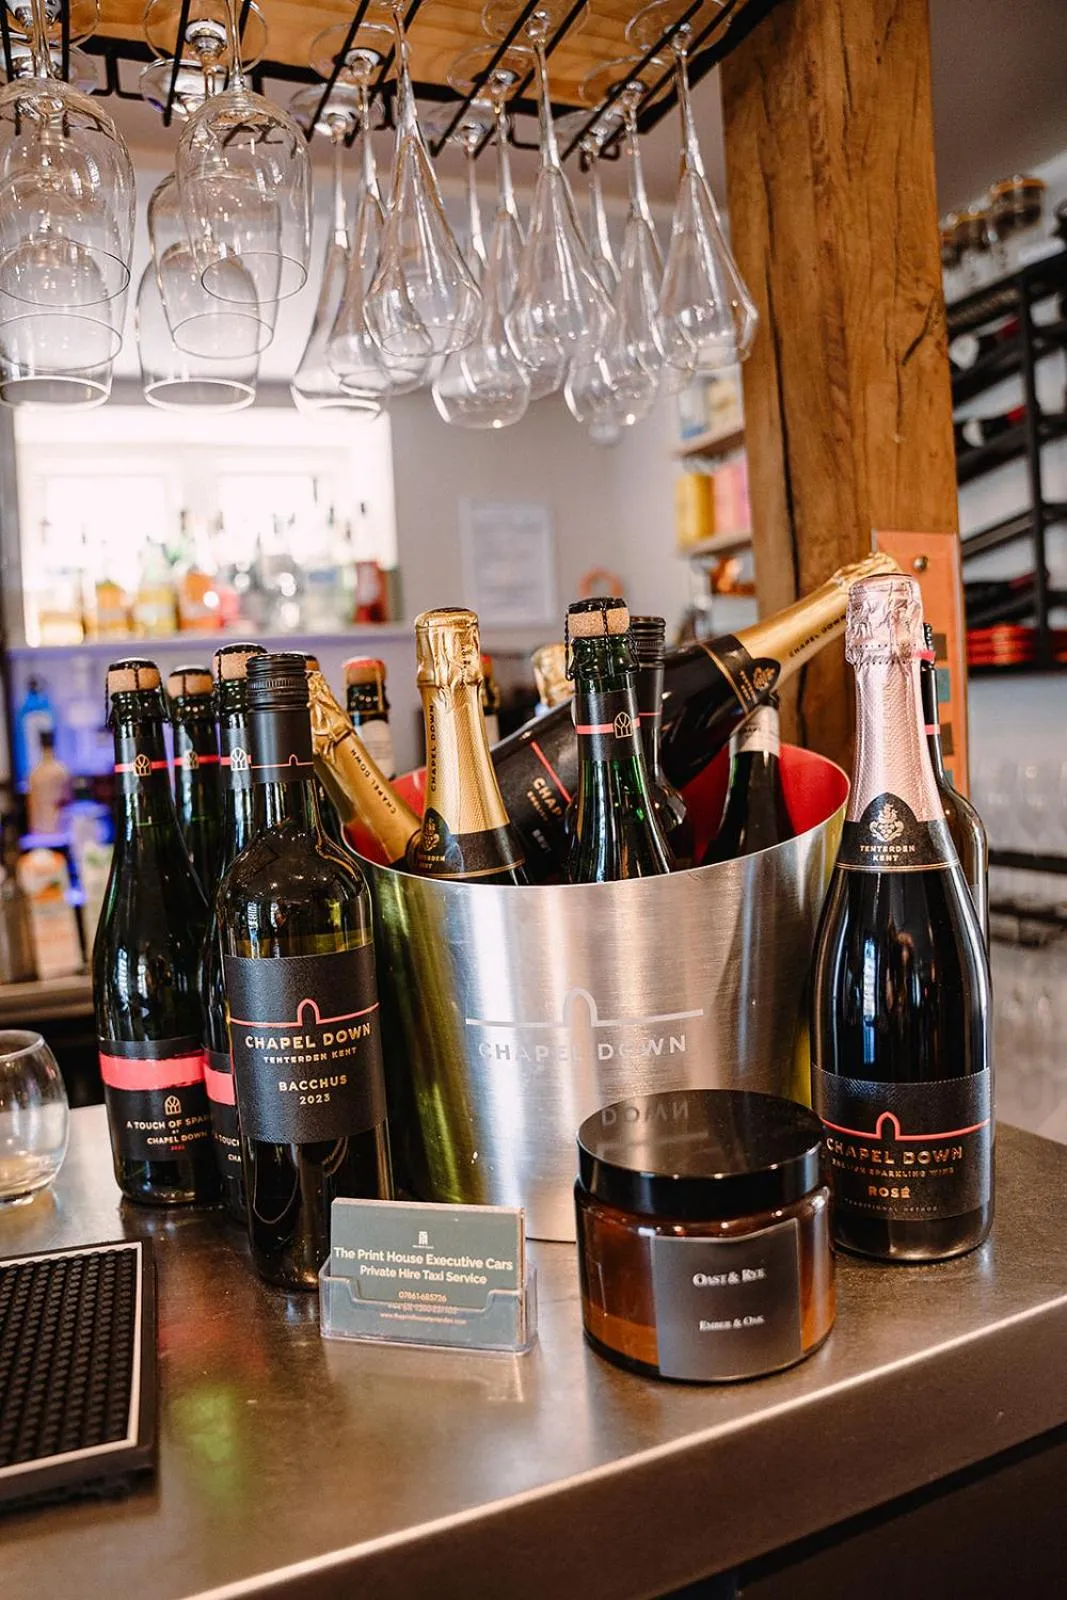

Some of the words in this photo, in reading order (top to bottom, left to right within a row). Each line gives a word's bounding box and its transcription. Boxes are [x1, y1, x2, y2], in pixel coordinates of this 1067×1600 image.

[429, 704, 437, 741] DOWN
[872, 854, 899, 862] KENT
[244, 1035, 317, 1050] CHAPEL
[322, 1022, 372, 1047] DOWN
[263, 1053, 328, 1064] TENTERDEN
[331, 1046, 357, 1059] KENT
[478, 1041, 582, 1061] CHAPEL
[597, 1034, 687, 1061] DOWN
[278, 1074, 348, 1092] BACCHUS
[299, 1093, 331, 1105] 2023
[126, 1120, 133, 1129] A
[134, 1121, 166, 1130] TOUCH
[168, 1119, 182, 1129] OF
[146, 1136, 180, 1145] CHAPEL
[180, 1131, 208, 1142] DOWN
[826, 1137, 895, 1165] CHAPEL
[902, 1146, 963, 1164] DOWN
[868, 1185, 912, 1199] ROSÉ
[333, 1246, 356, 1260] The
[357, 1249, 385, 1262] Print
[387, 1251, 424, 1265] House
[426, 1253, 484, 1269] Executive
[485, 1257, 514, 1271] Cars
[359, 1264, 397, 1278] Private
[398, 1267, 421, 1280] Hire
[422, 1269, 444, 1282] Taxi
[445, 1270, 488, 1285] Service
